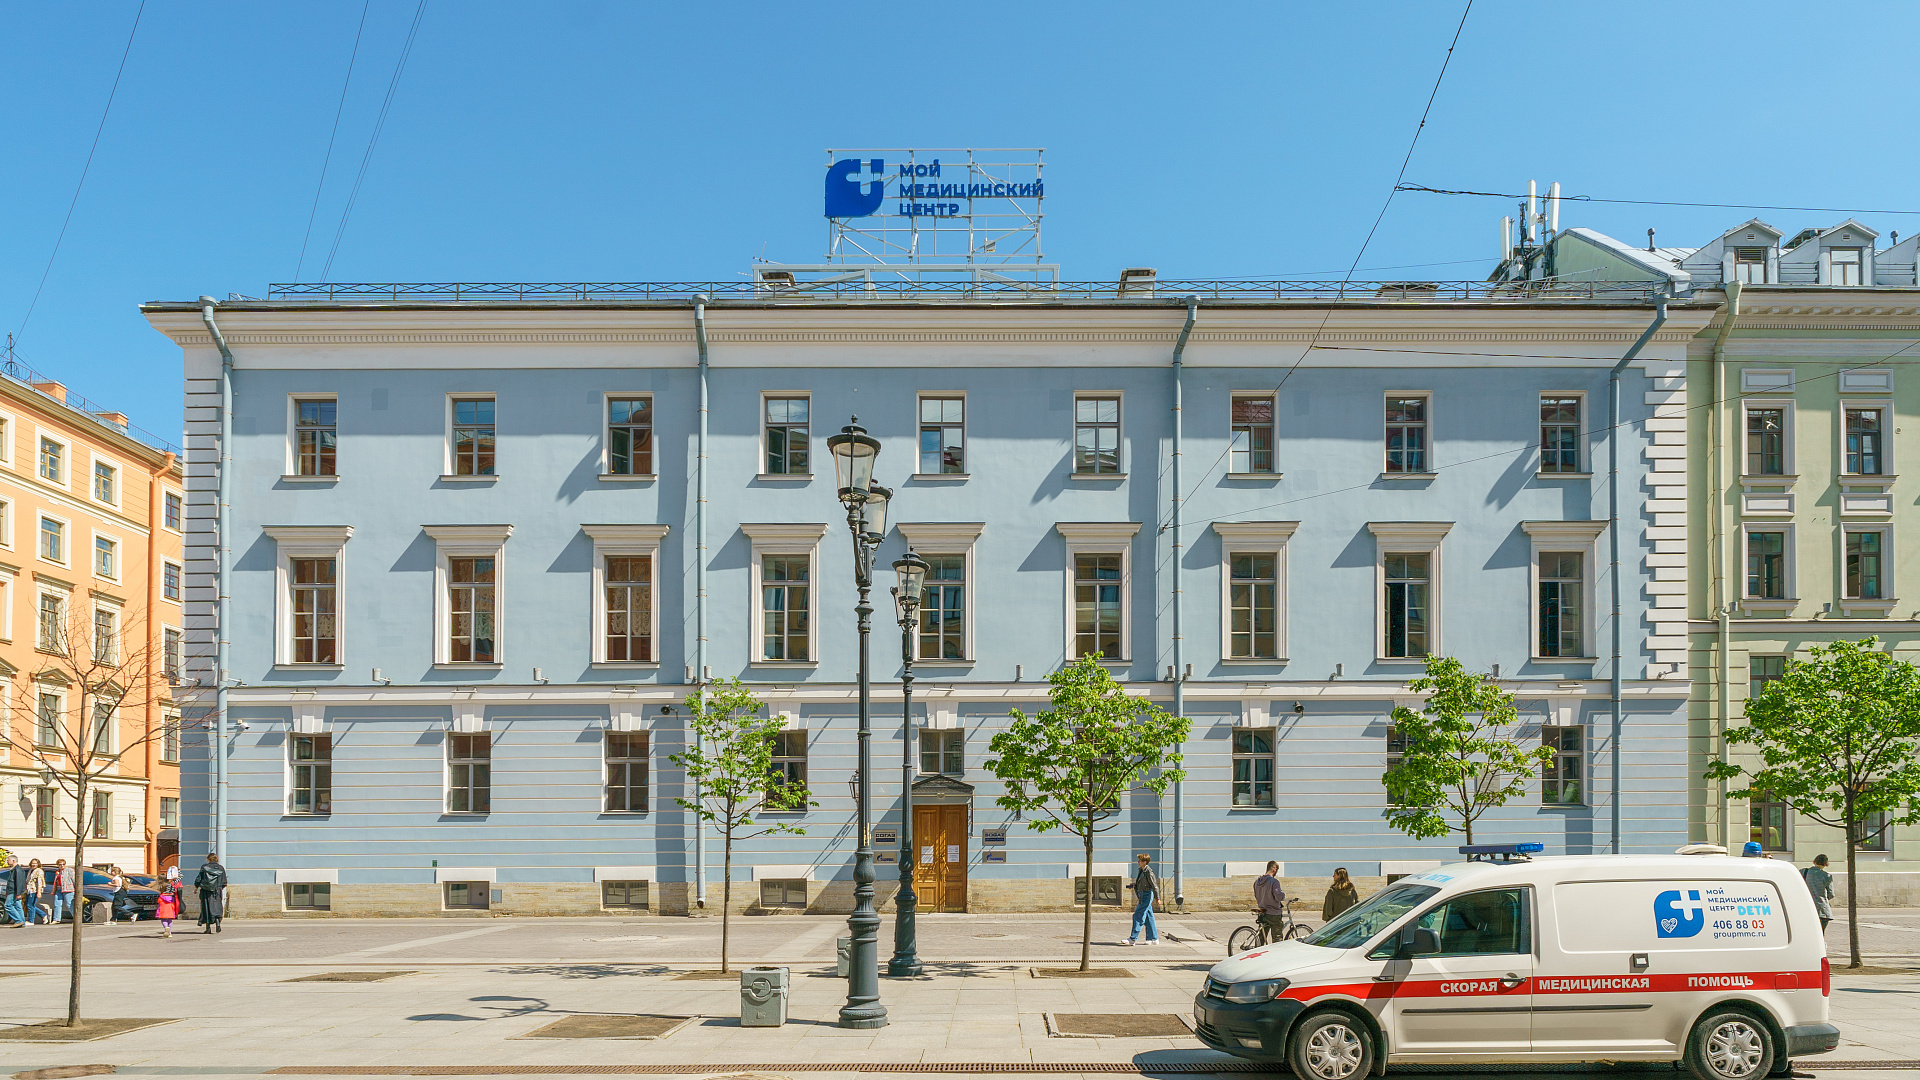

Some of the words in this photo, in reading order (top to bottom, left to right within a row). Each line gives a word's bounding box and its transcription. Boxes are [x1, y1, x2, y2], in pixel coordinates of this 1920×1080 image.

[899, 159, 941, 178] МОЙ
[899, 179, 1044, 199] МЕДИЦИНСКИЙ
[899, 203, 960, 218] ЦЕНТР
[1705, 887, 1725, 895] МОЙ
[1707, 895, 1769, 904] МЕДИЦИНСКИЙ
[1712, 919, 1733, 930] 406
[1735, 919, 1749, 930] 88
[1751, 919, 1765, 930] 03
[1713, 931, 1767, 940] groupmmc.ru
[1440, 981, 1498, 994] СКОРАЯ
[1538, 977, 1650, 992] МЕДИЦИНСКАЯ
[1687, 975, 1754, 987] ПОМОЩЬ
